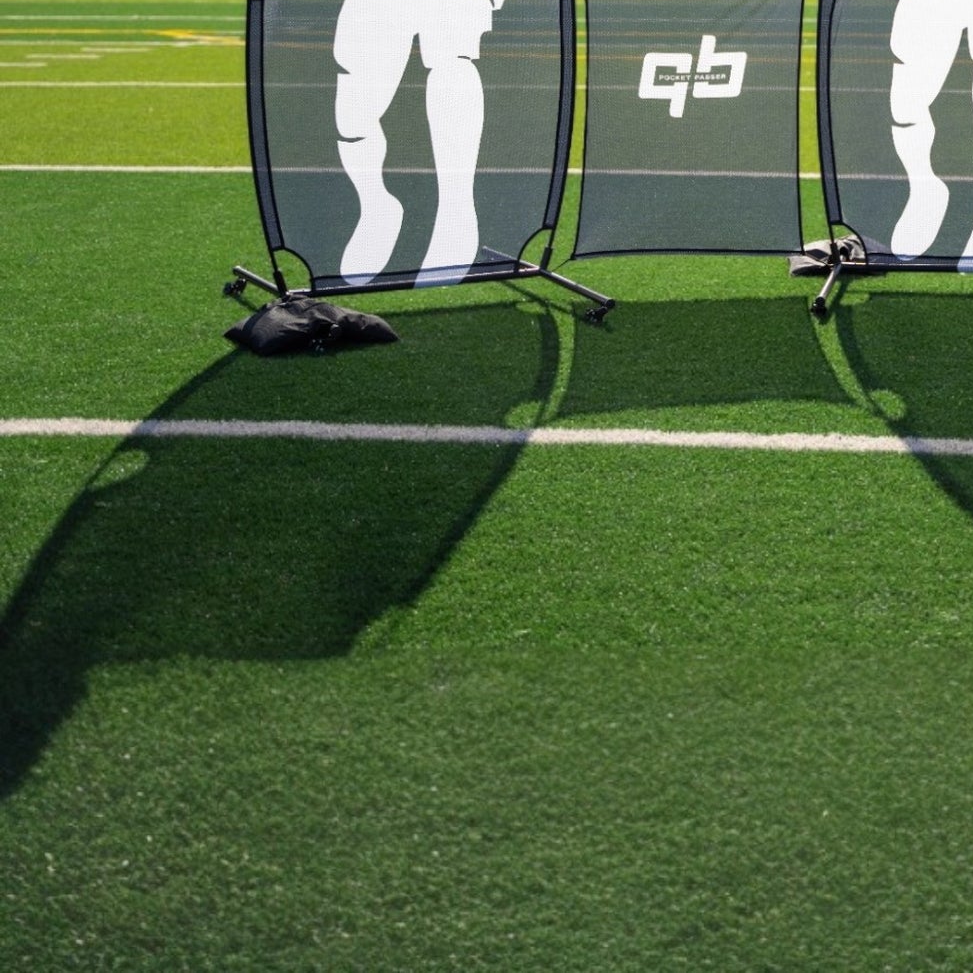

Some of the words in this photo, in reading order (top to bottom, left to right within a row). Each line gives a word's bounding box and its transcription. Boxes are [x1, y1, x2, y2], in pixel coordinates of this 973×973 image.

[638, 35, 747, 118] qb
[658, 74, 691, 82] POCKET
[694, 73, 726, 81] PASSER
